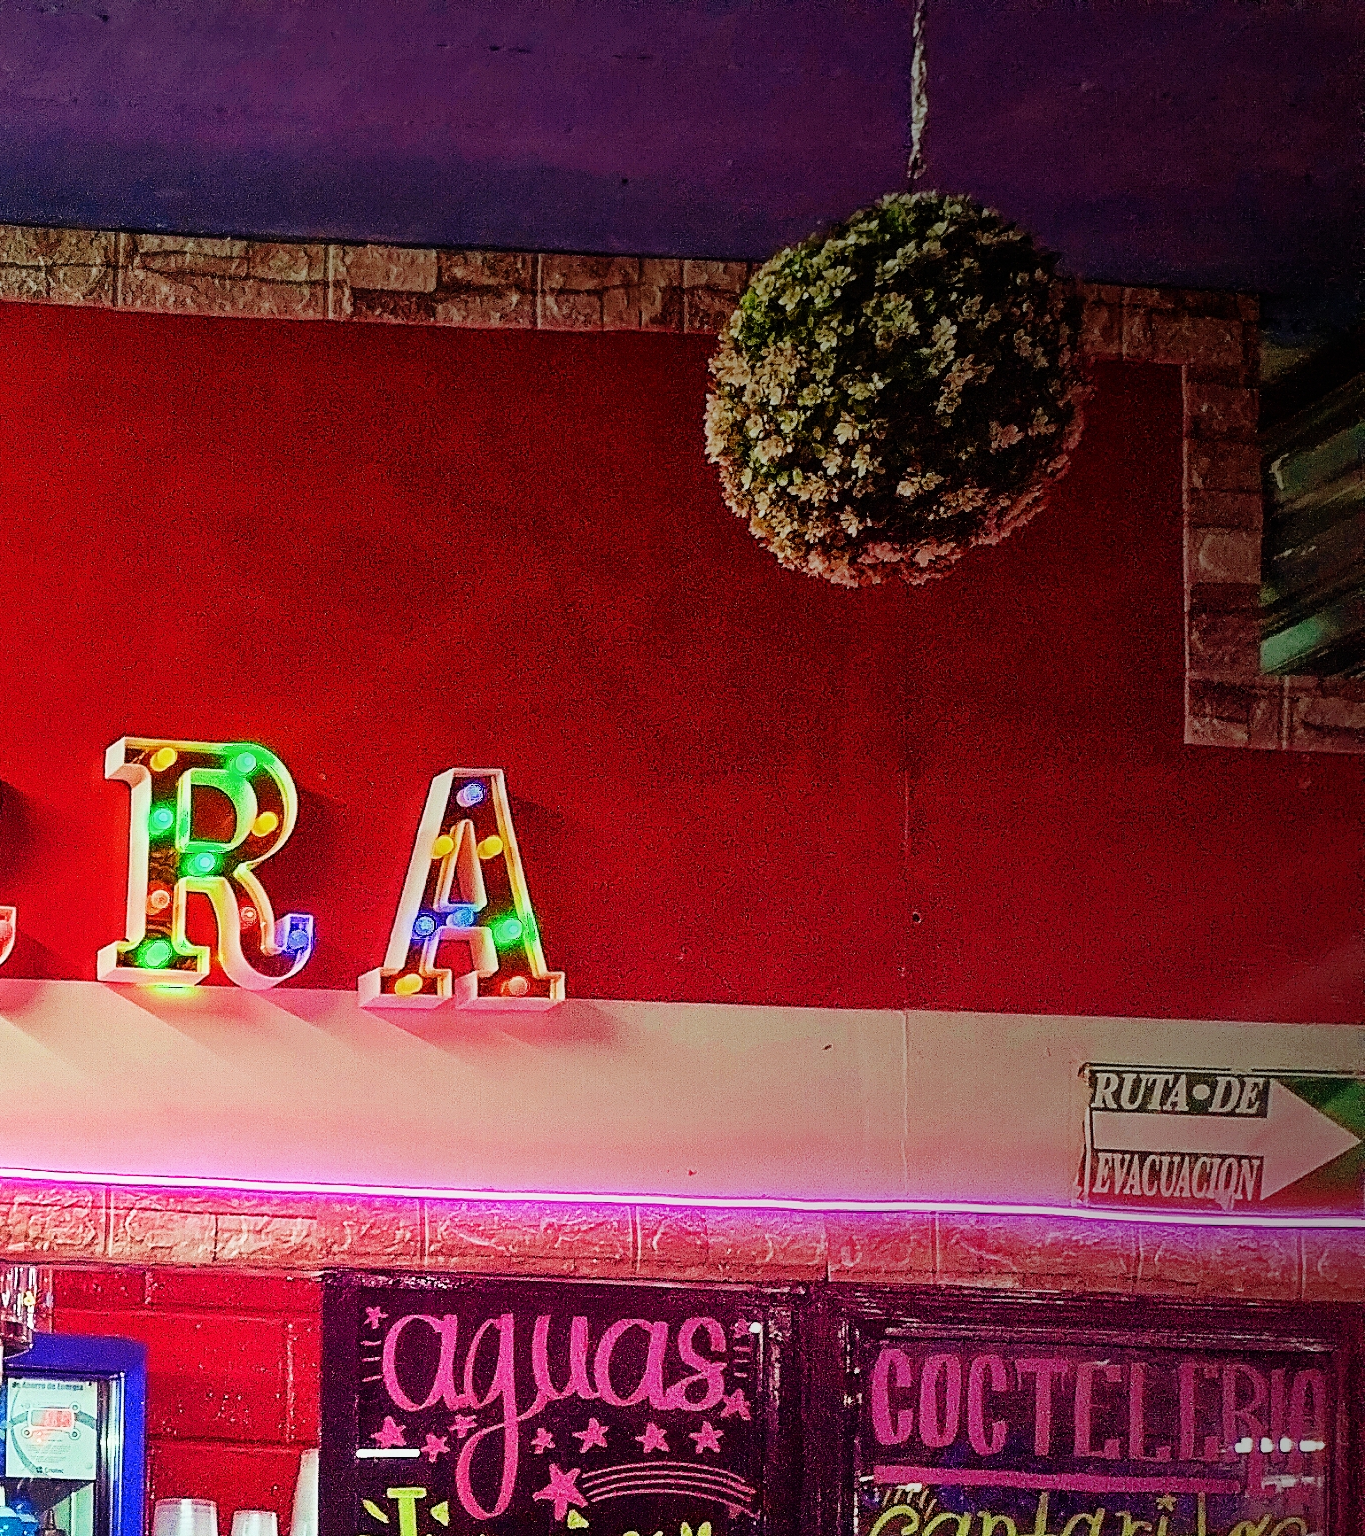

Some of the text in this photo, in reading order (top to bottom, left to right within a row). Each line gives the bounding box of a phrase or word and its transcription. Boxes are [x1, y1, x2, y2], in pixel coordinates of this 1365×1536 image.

[1091, 1072, 1268, 1114] RUTA DE
[382, 1313, 728, 1520] aguas
